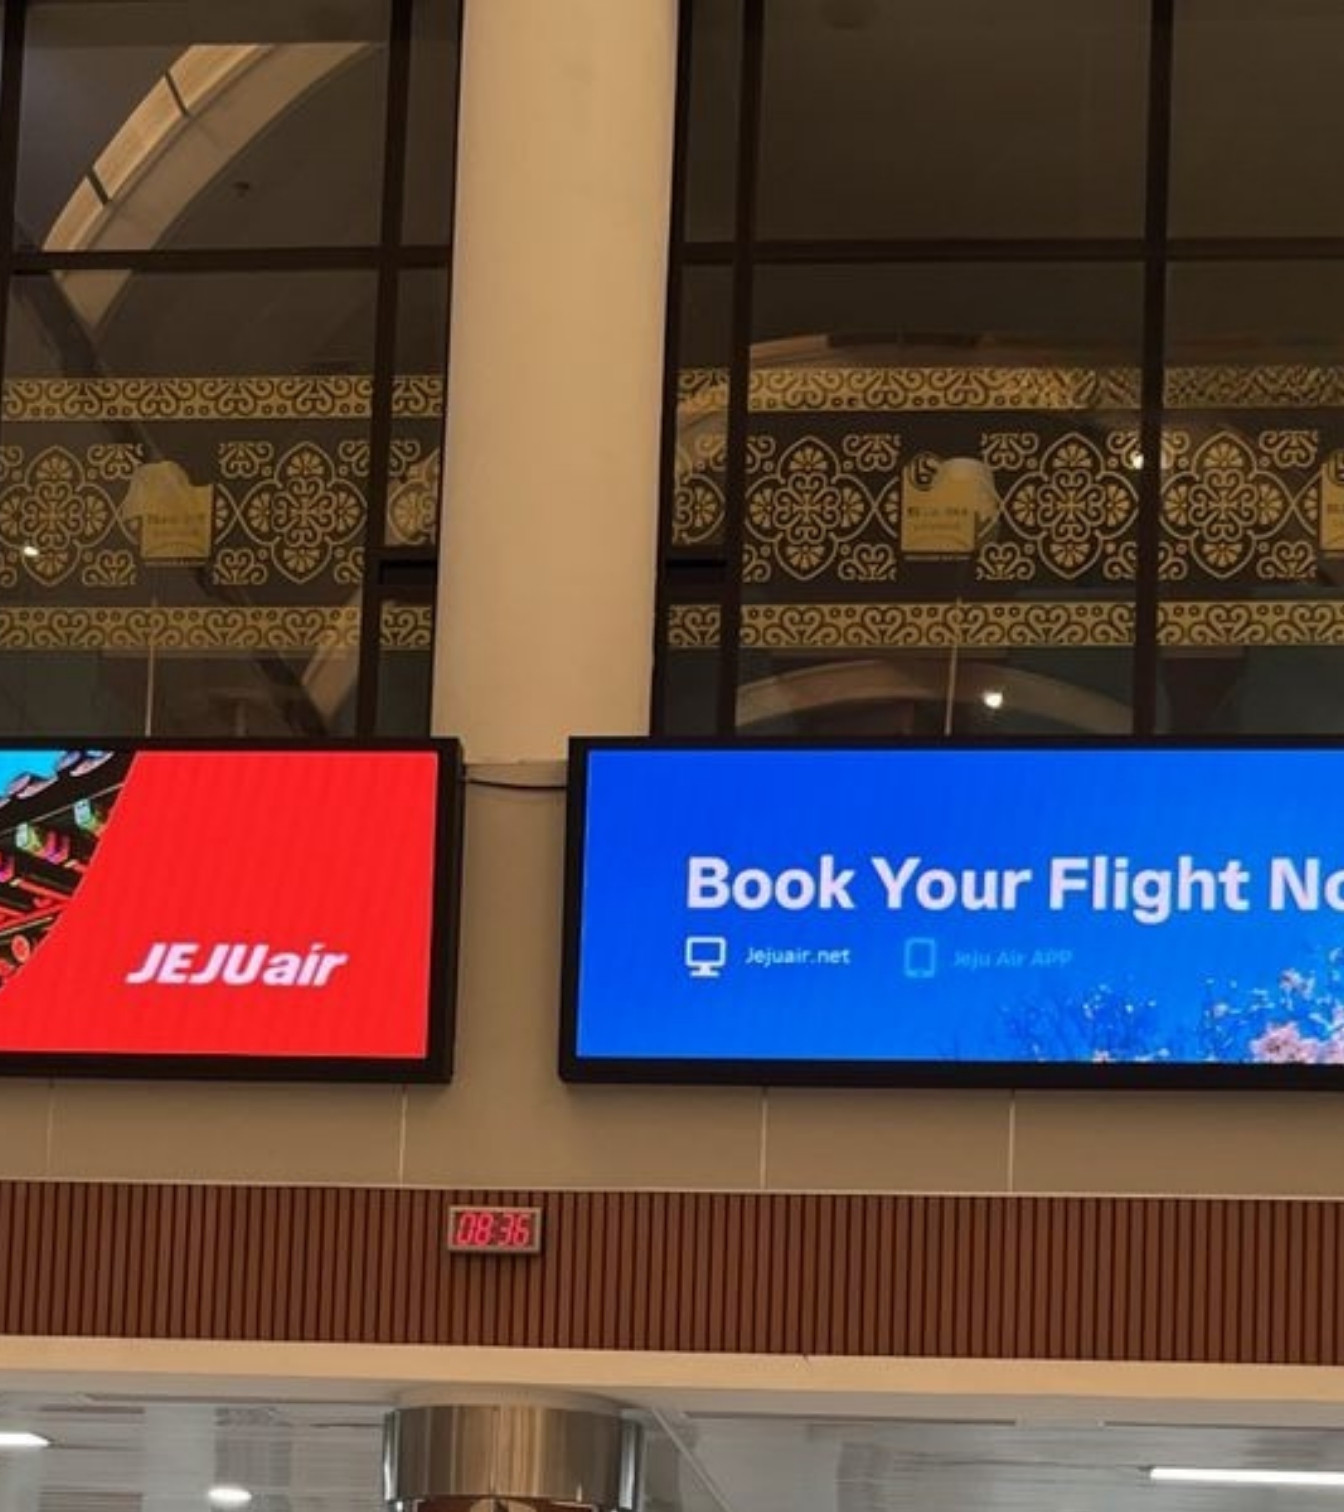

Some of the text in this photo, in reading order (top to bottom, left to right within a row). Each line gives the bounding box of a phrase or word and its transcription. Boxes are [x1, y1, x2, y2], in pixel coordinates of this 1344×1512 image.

[686, 854, 855, 910] Book
[870, 856, 1032, 911] Your
[1049, 855, 1250, 924] Flight
[125, 942, 349, 987] JEJUair
[745, 947, 850, 968] Jejuair.net
